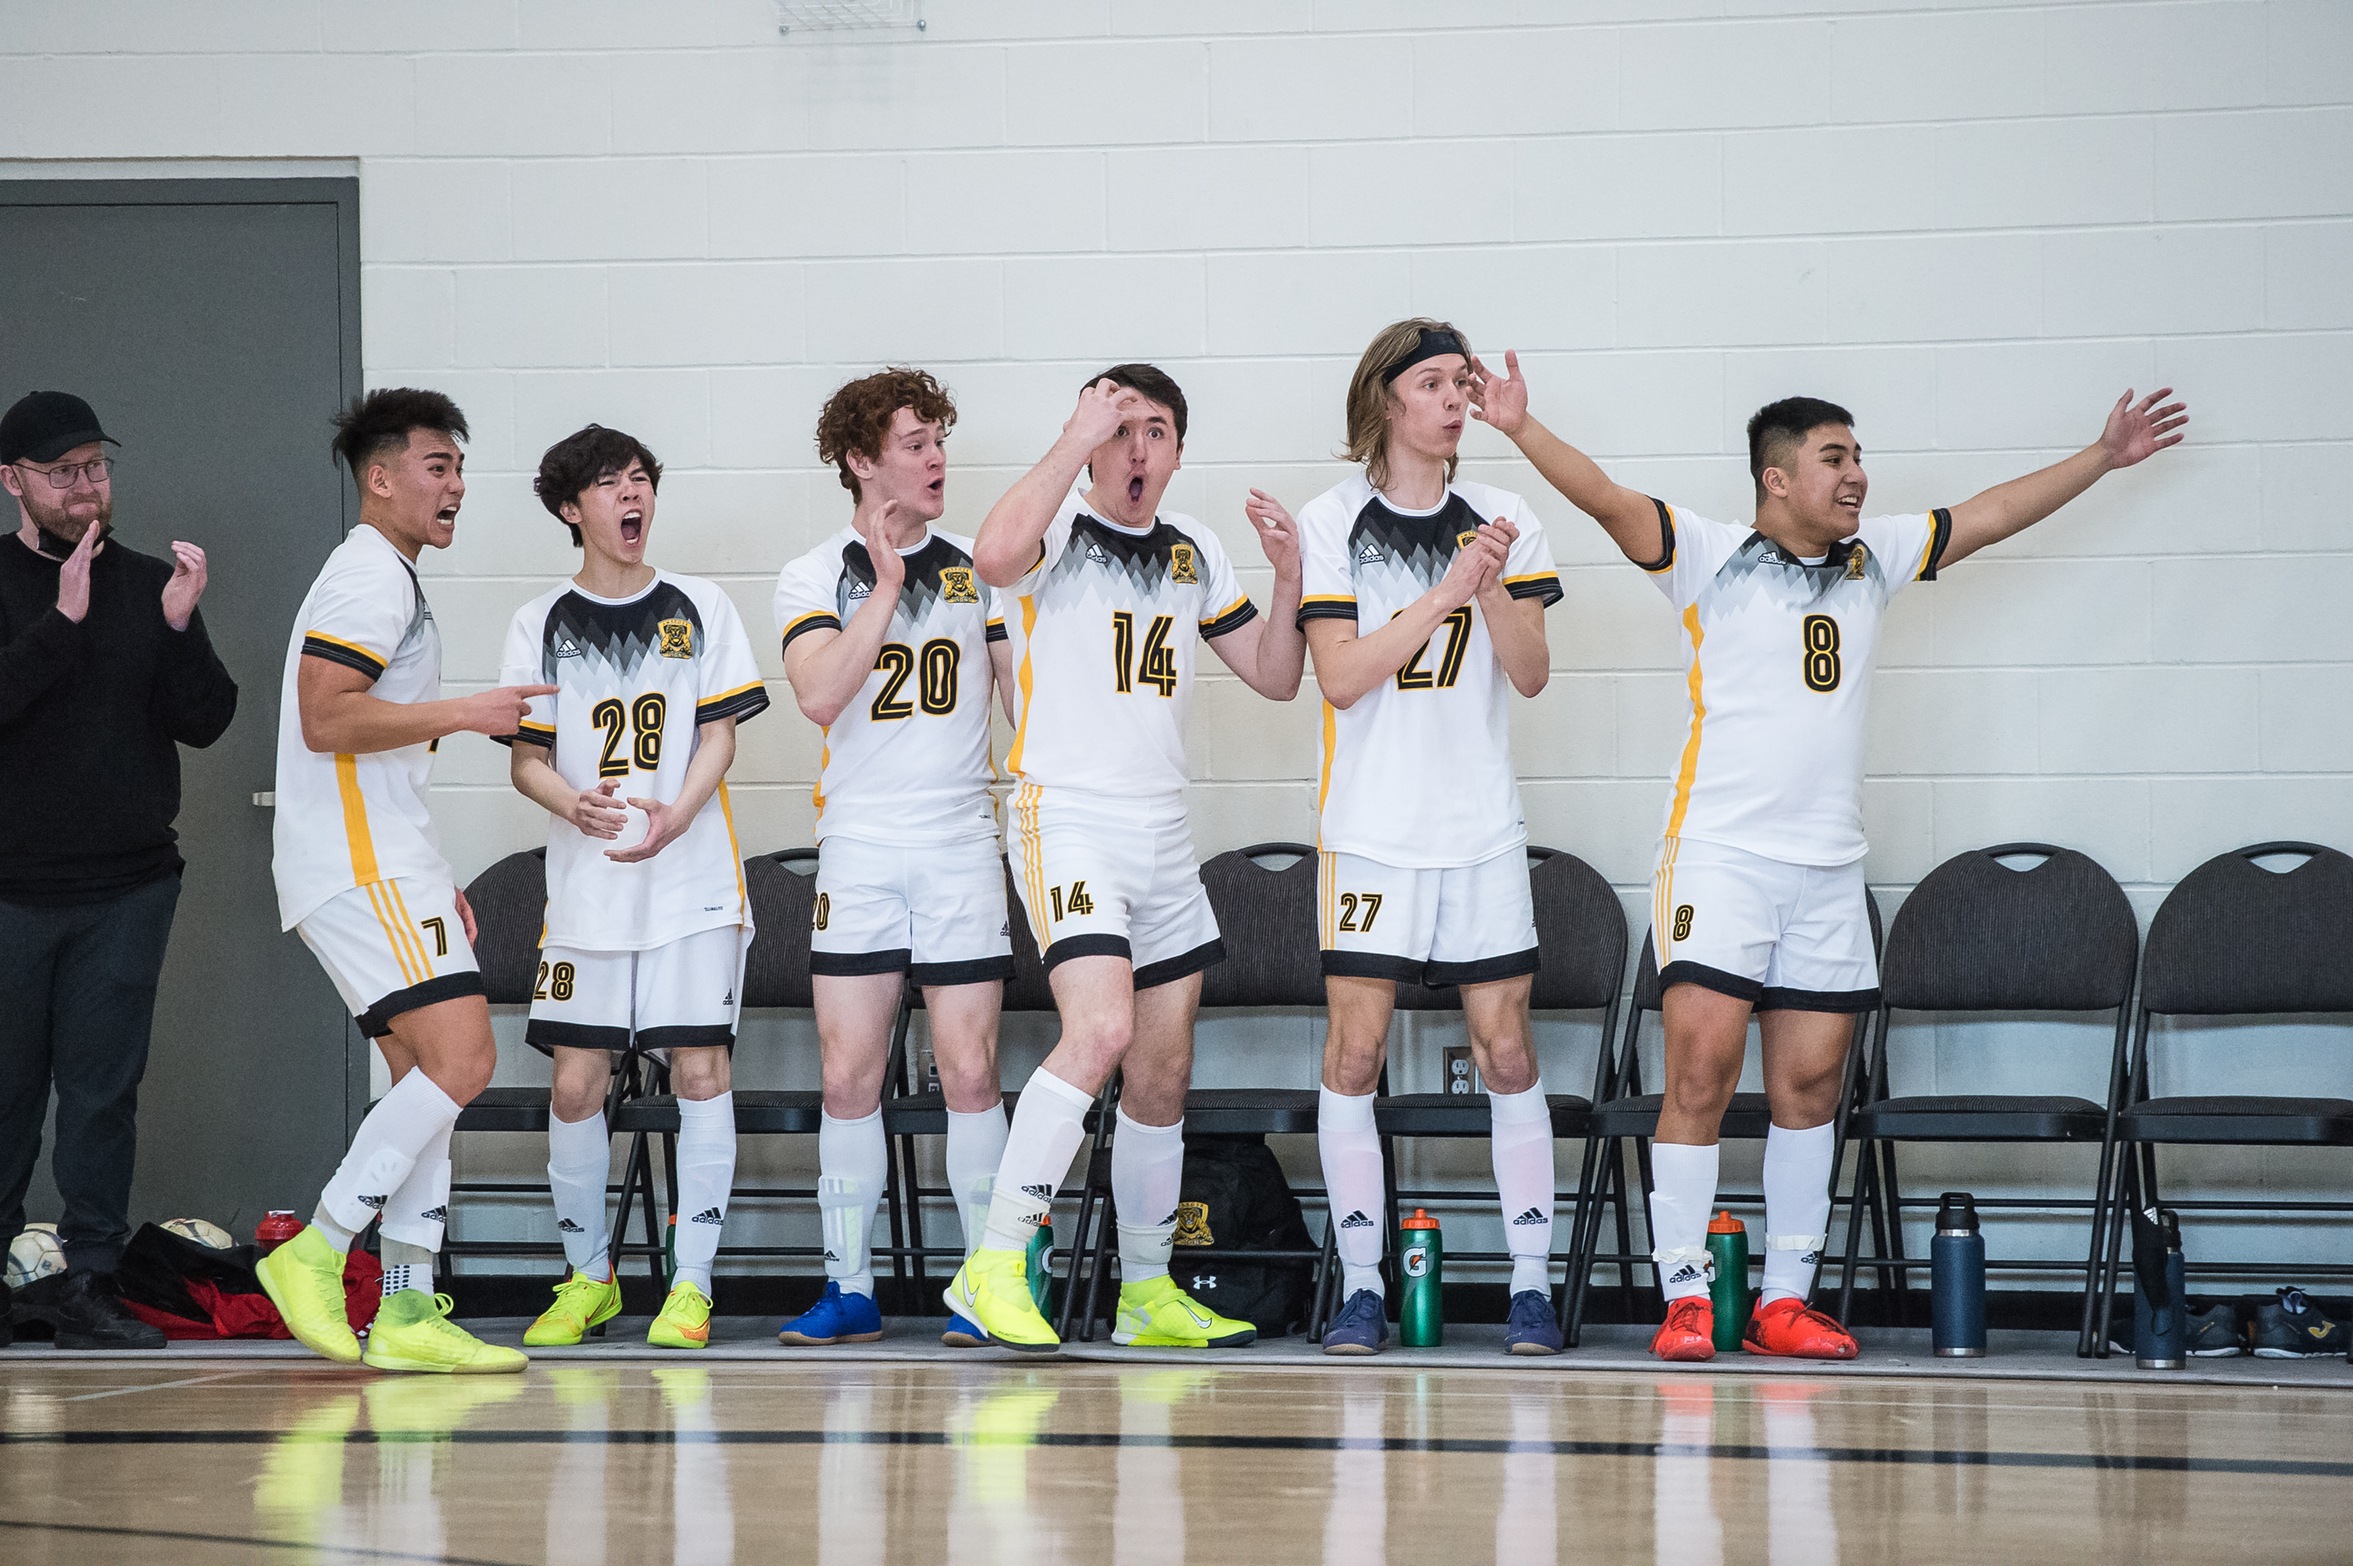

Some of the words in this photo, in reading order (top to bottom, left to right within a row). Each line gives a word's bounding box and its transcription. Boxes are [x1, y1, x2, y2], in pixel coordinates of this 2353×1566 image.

[1112, 610, 1177, 698] 14
[1802, 613, 1842, 695] 8
[870, 637, 961, 723] 20
[590, 691, 667, 779] 28
[1049, 880, 1094, 923] 14
[1338, 892, 1383, 933] 27
[1672, 903, 1695, 942] 8
[420, 915, 448, 957] 7
[533, 961, 576, 1001] 28
[1512, 1216, 1549, 1225] adidas
[1669, 1272, 1701, 1283] adidas
